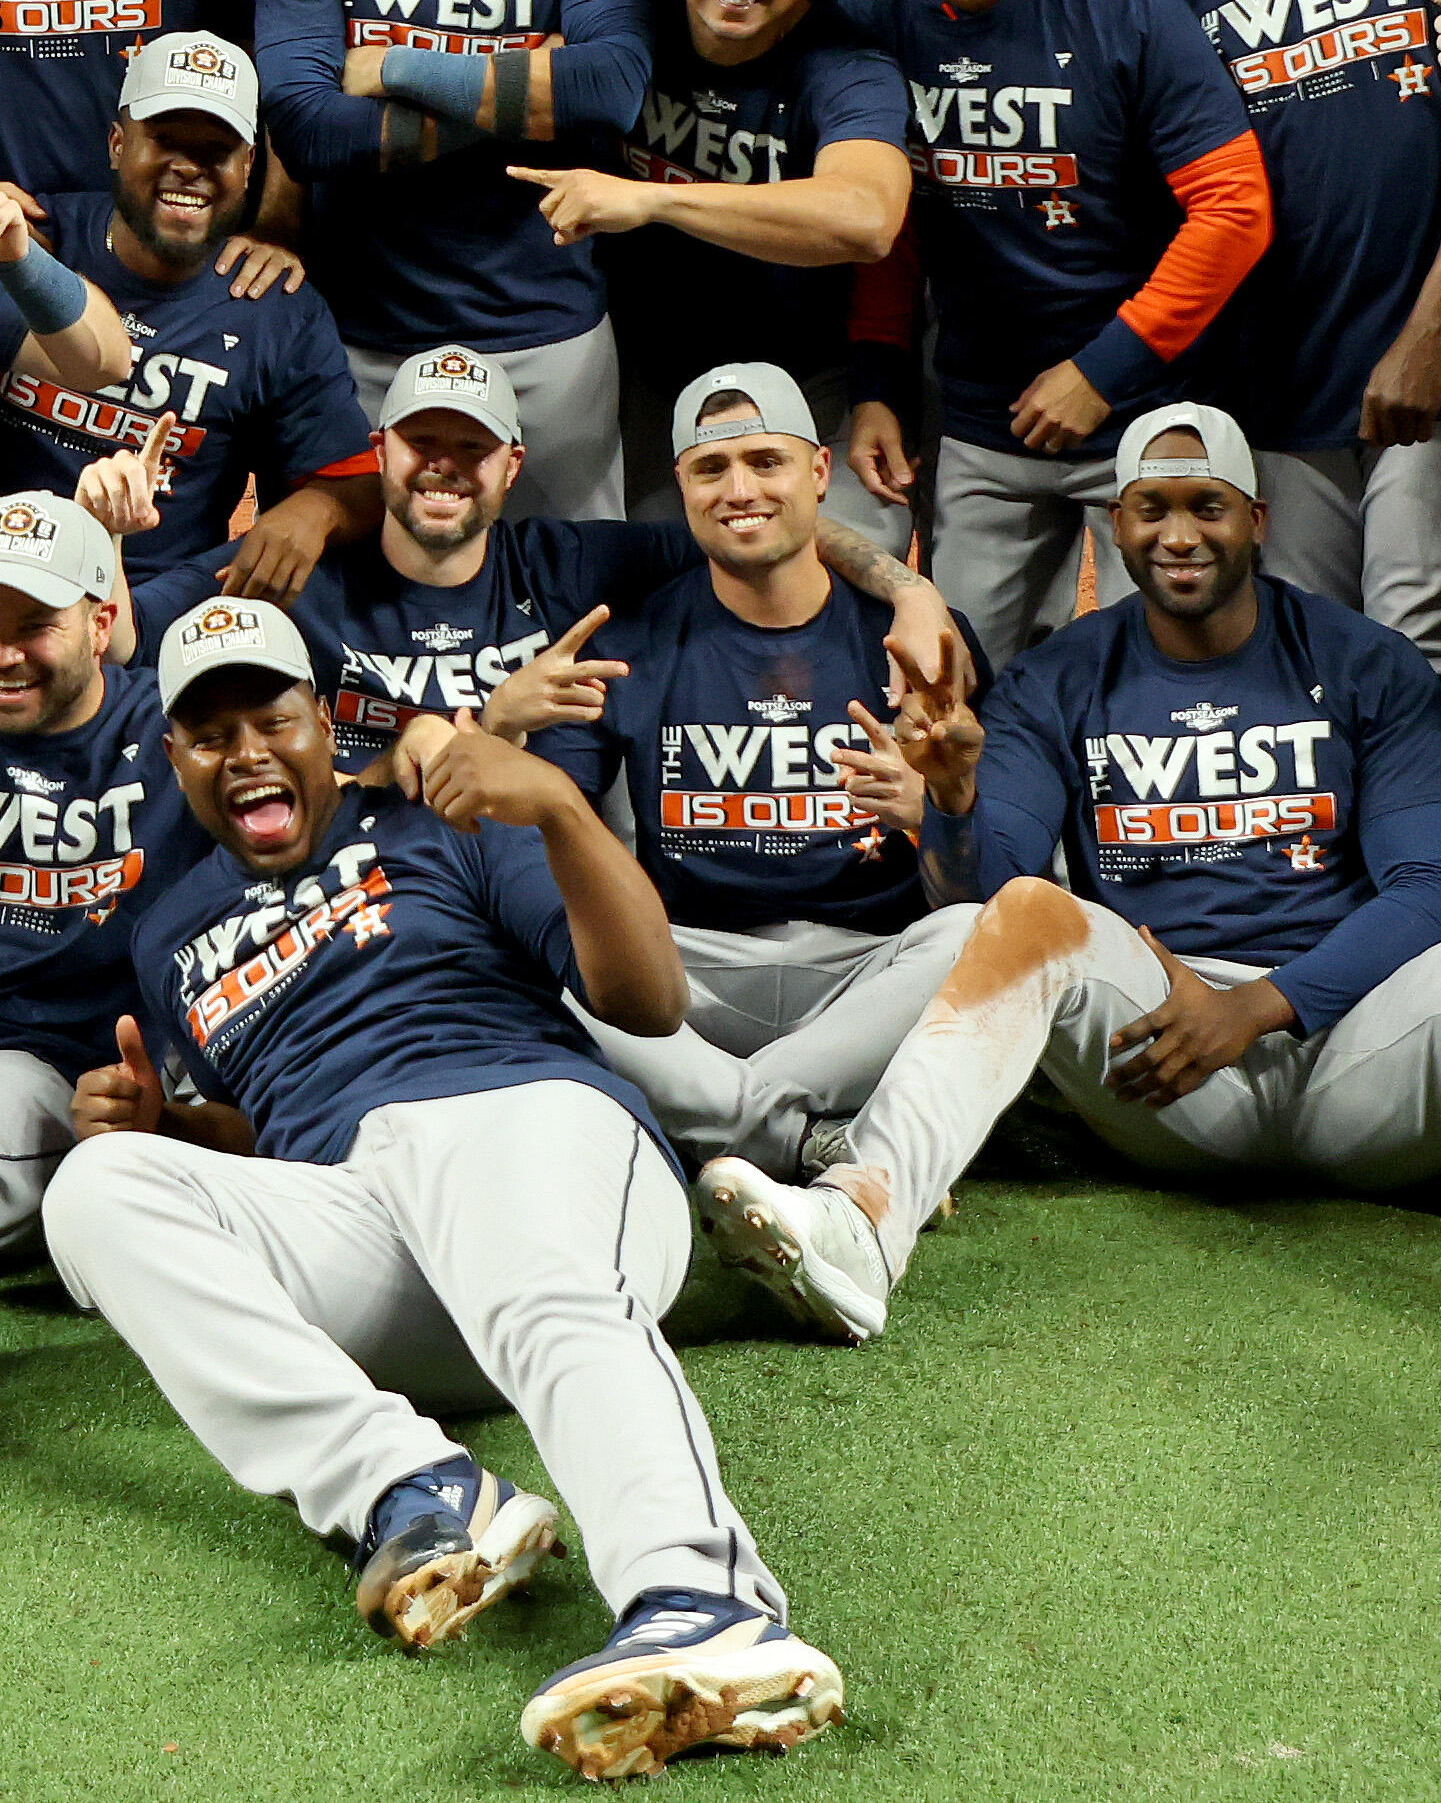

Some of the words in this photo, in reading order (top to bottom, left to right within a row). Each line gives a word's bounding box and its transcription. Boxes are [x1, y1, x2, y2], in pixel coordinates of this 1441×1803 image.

[1171, 706, 1238, 722] POSTSEASON
[1085, 738, 1112, 800] THE
[1106, 721, 1330, 800] WEST
[1114, 808, 1154, 841] IS
[1170, 798, 1313, 839] OURS
